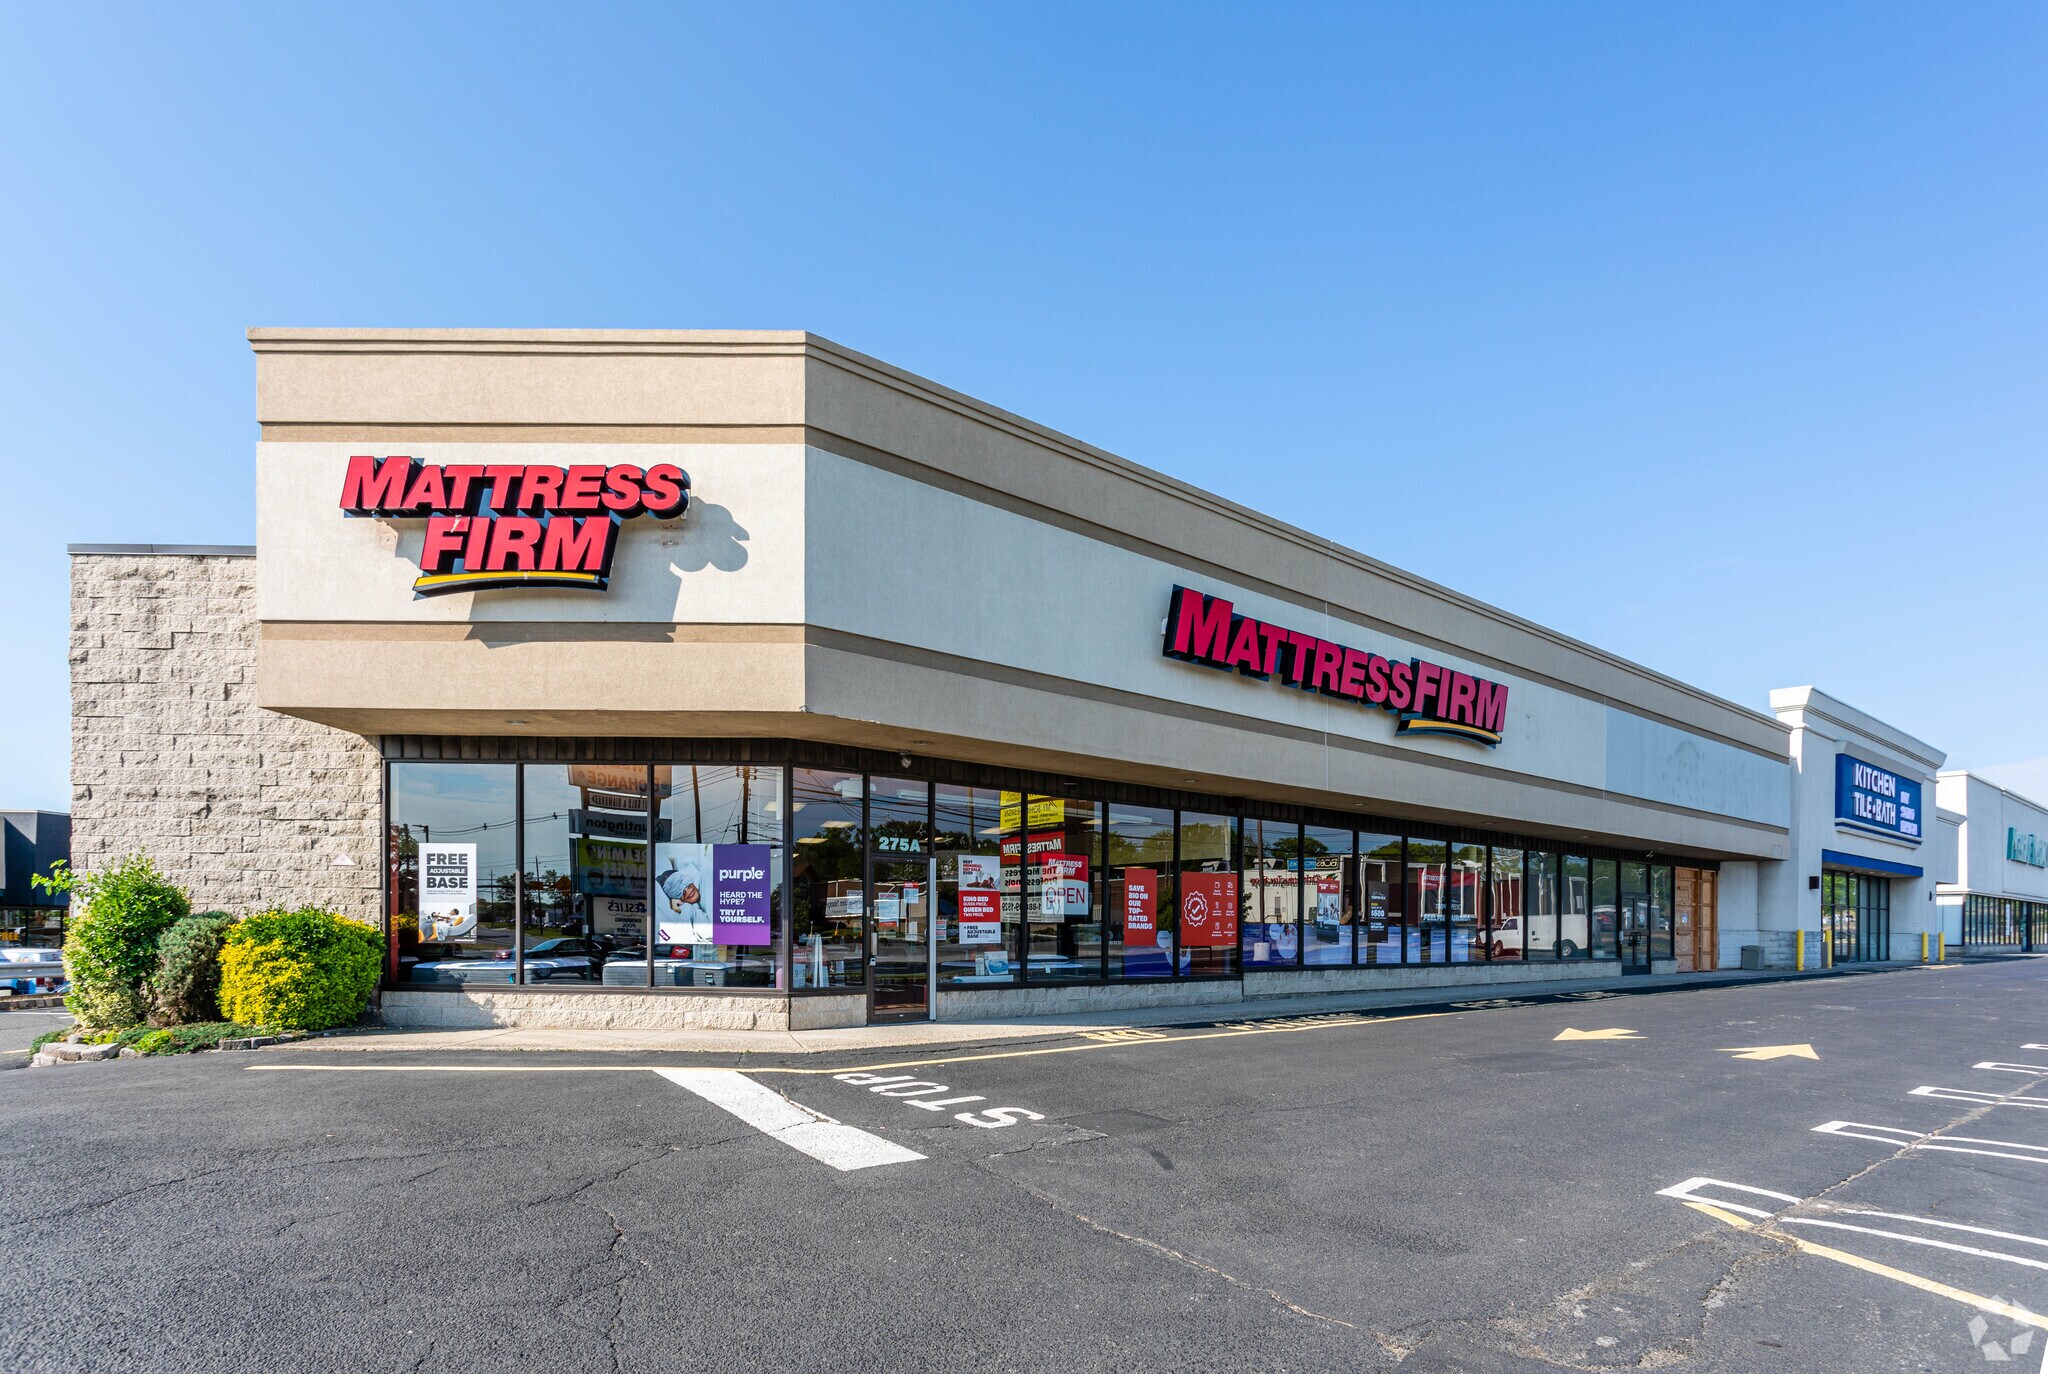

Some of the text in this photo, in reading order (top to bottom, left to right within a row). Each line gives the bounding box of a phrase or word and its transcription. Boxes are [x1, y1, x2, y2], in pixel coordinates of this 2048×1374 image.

[340, 456, 691, 516] MATTRESS
[420, 515, 614, 572] FIRM
[1168, 586, 1508, 733] MATTRESS FIRM
[1854, 763, 1896, 798] KITCHEN
[879, 836, 921, 852] 275A
[427, 853, 468, 865] FREE
[430, 867, 466, 875] ADJUSTABLE
[719, 866, 766, 881] purple
[427, 877, 468, 889] BASE
[1128, 884, 1145, 892] SAVE
[1045, 887, 1085, 904] OPEN
[1128, 922, 1153, 930] BRANDS
[833, 1073, 1046, 1129] STOP
